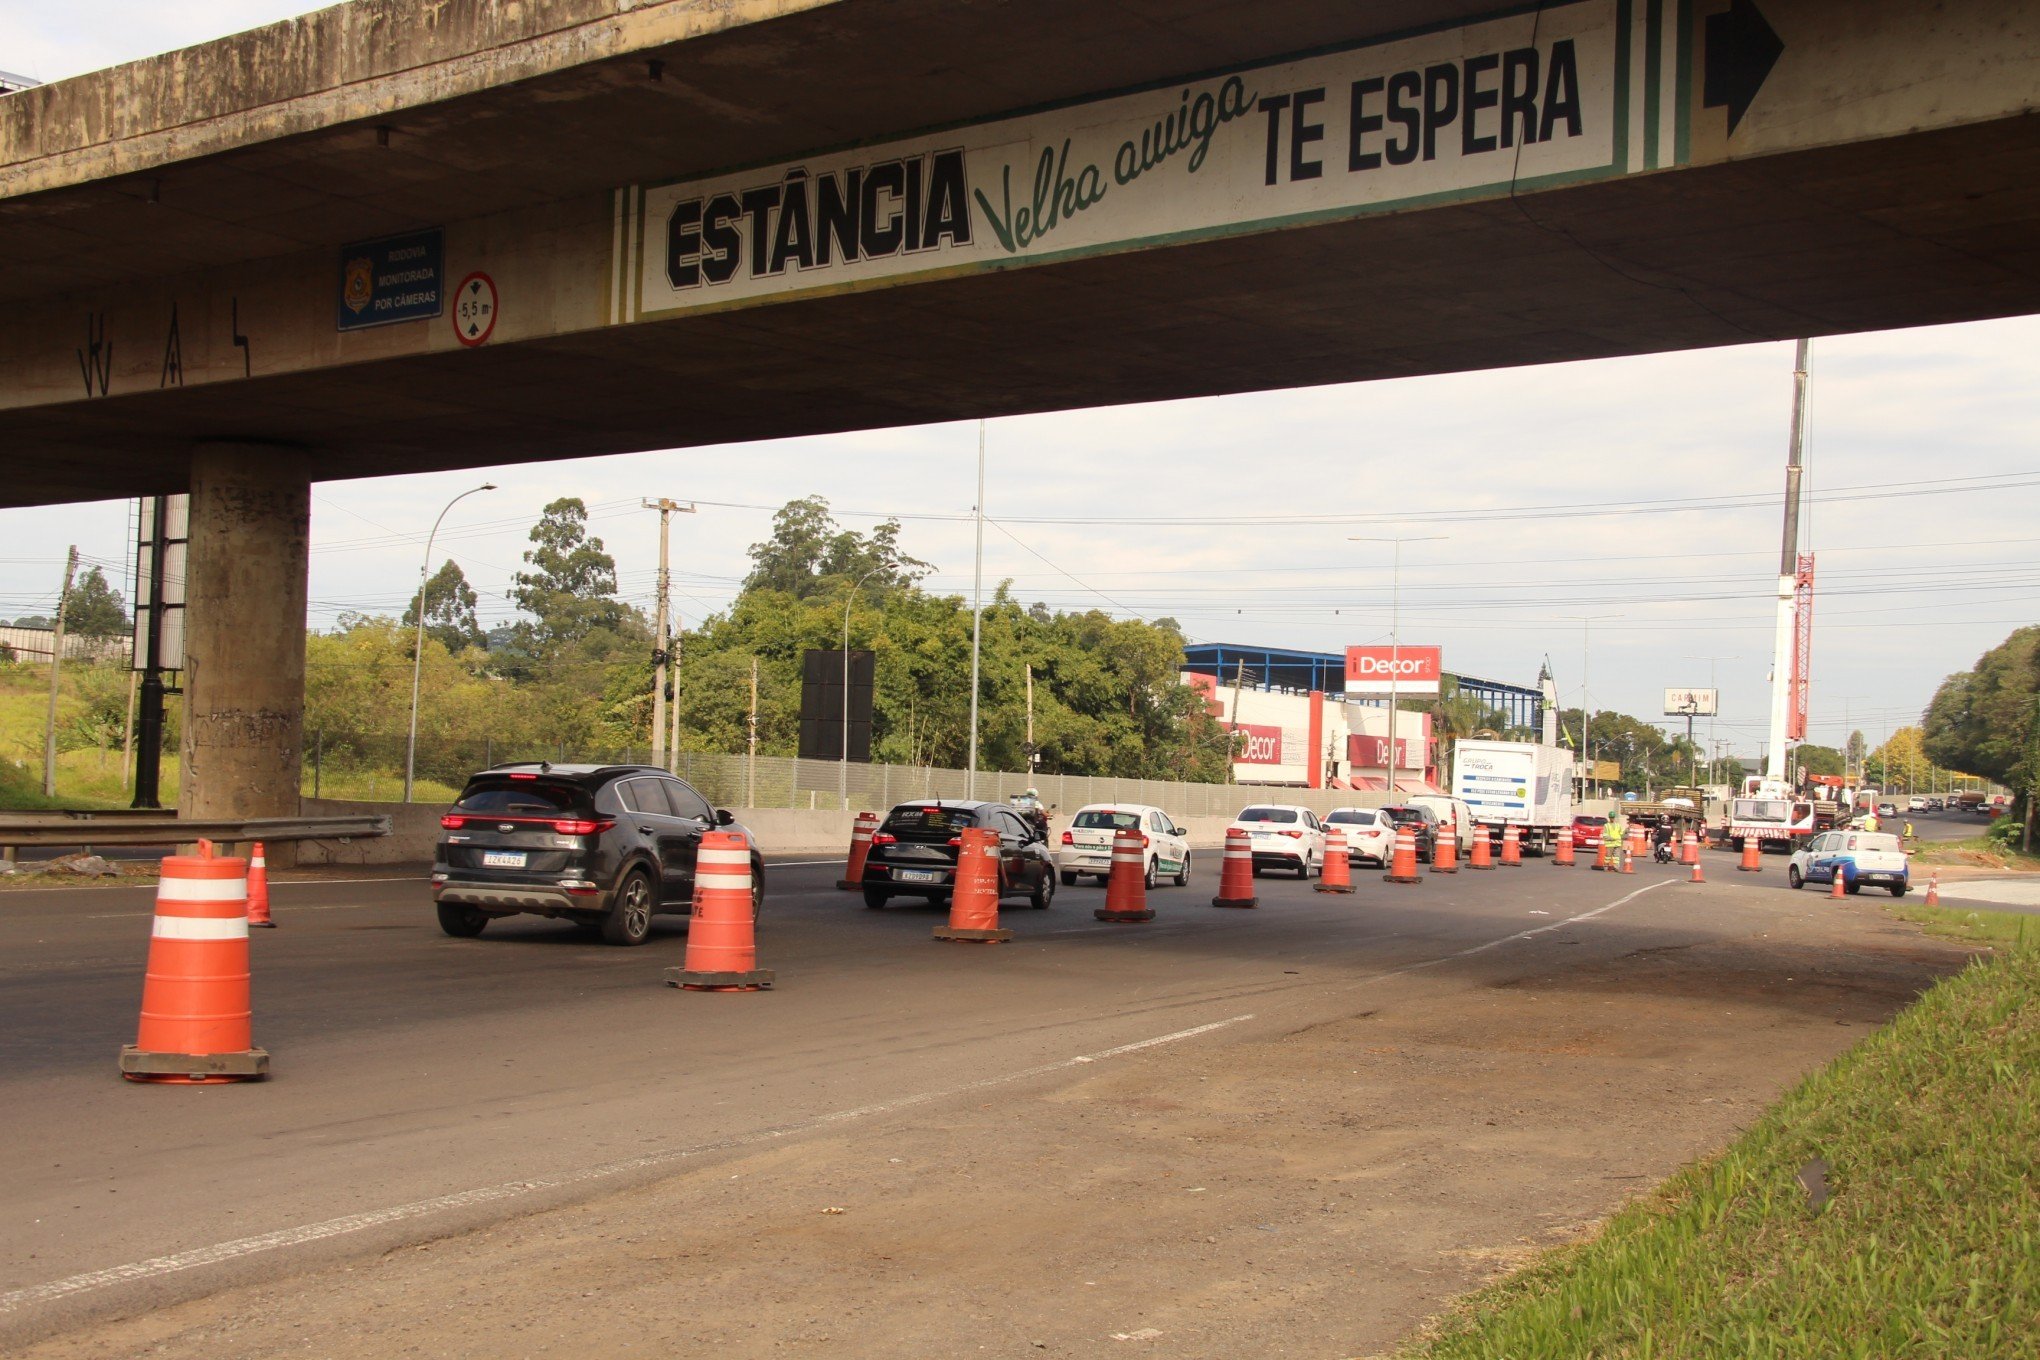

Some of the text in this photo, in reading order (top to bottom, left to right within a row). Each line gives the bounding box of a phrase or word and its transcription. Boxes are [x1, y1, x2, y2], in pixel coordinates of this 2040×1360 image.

[666, 38, 1583, 291] ESTÂNCIA Velha amiga TE ESPERA
[388, 246, 427, 262] RODOVIA
[378, 268, 434, 287] MONITORADA
[375, 290, 436, 311] POR CÂMERAS
[462, 301, 489, 320] 5,5 m
